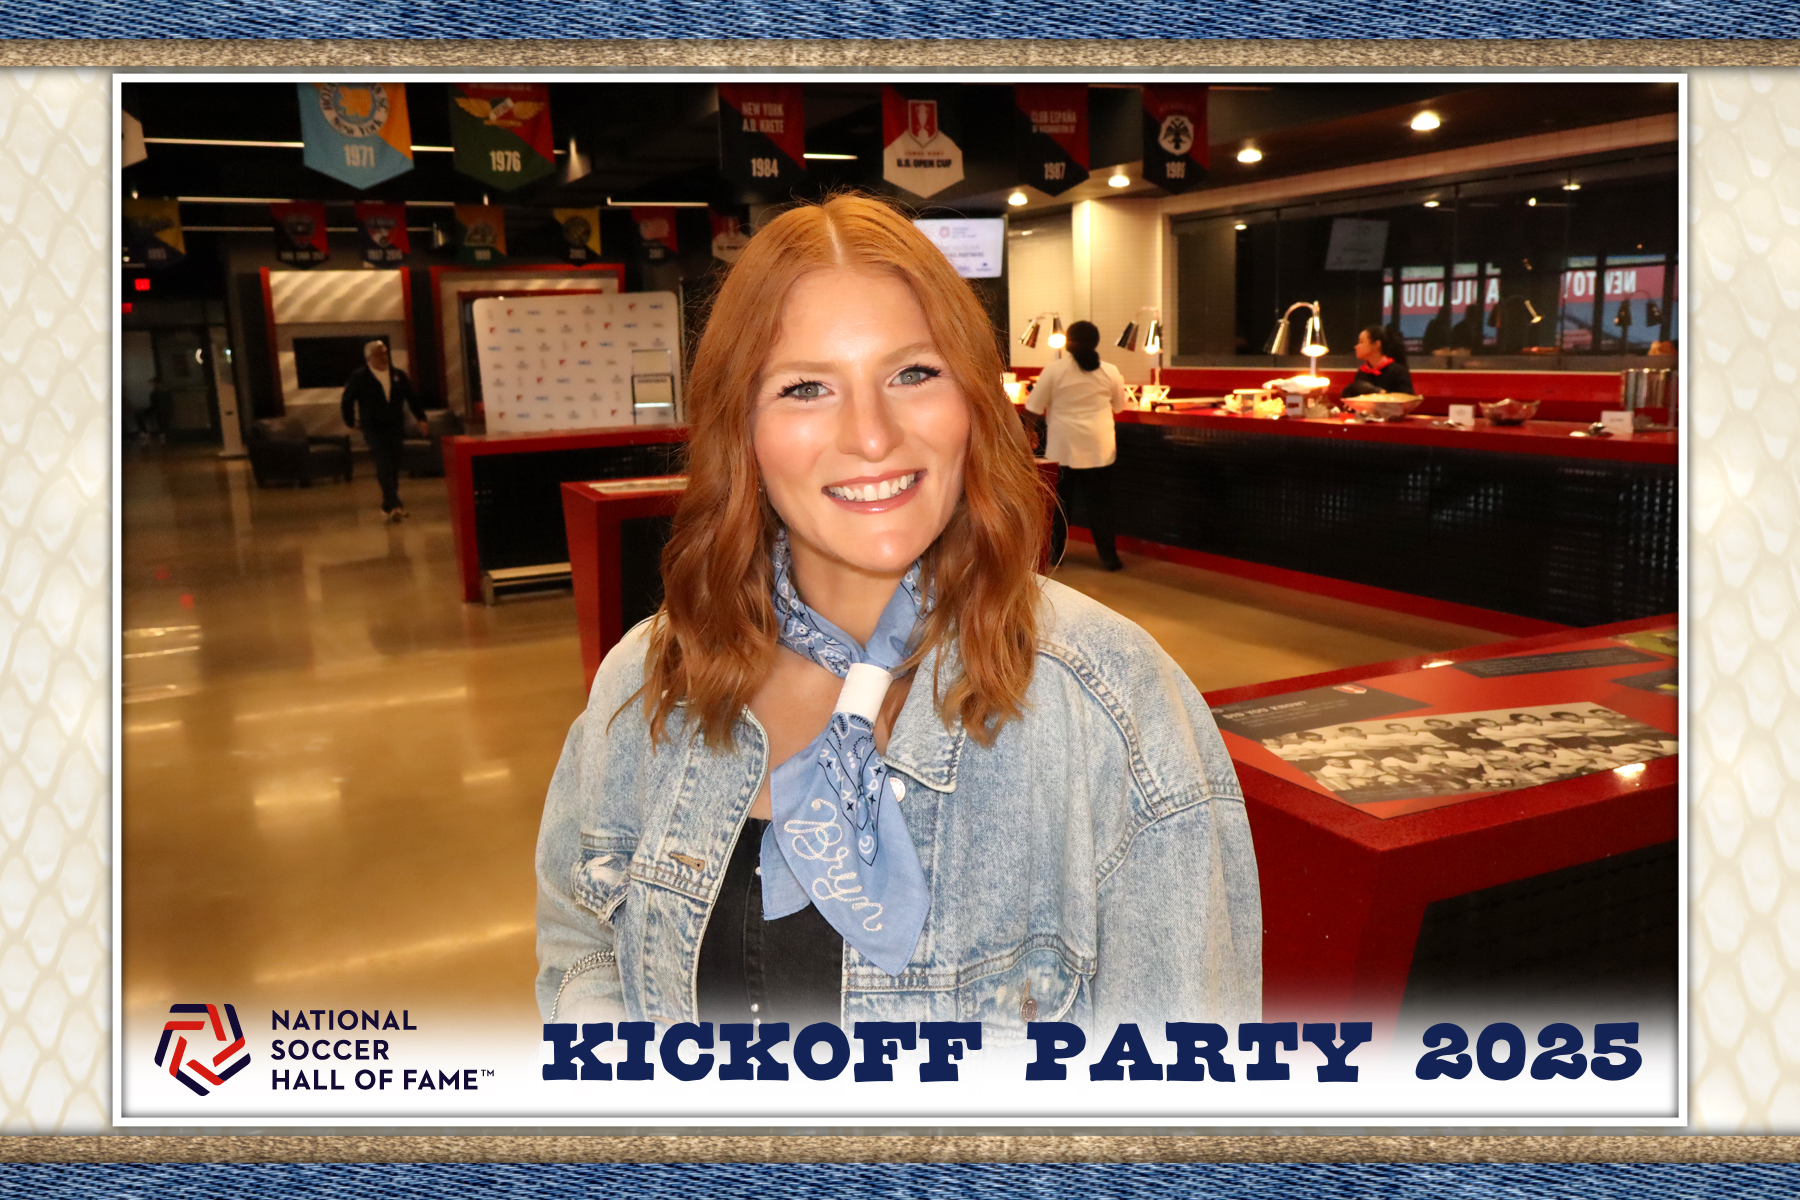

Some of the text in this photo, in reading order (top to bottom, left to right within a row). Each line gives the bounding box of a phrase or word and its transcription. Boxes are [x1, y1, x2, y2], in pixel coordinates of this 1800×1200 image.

[343, 144, 375, 168] 1971
[489, 150, 522, 173] 1976
[896, 158, 953, 169] U.S. OPEN CUP
[751, 157, 779, 178] 1984
[1044, 162, 1066, 181] 1987
[784, 798, 884, 931] Bryn
